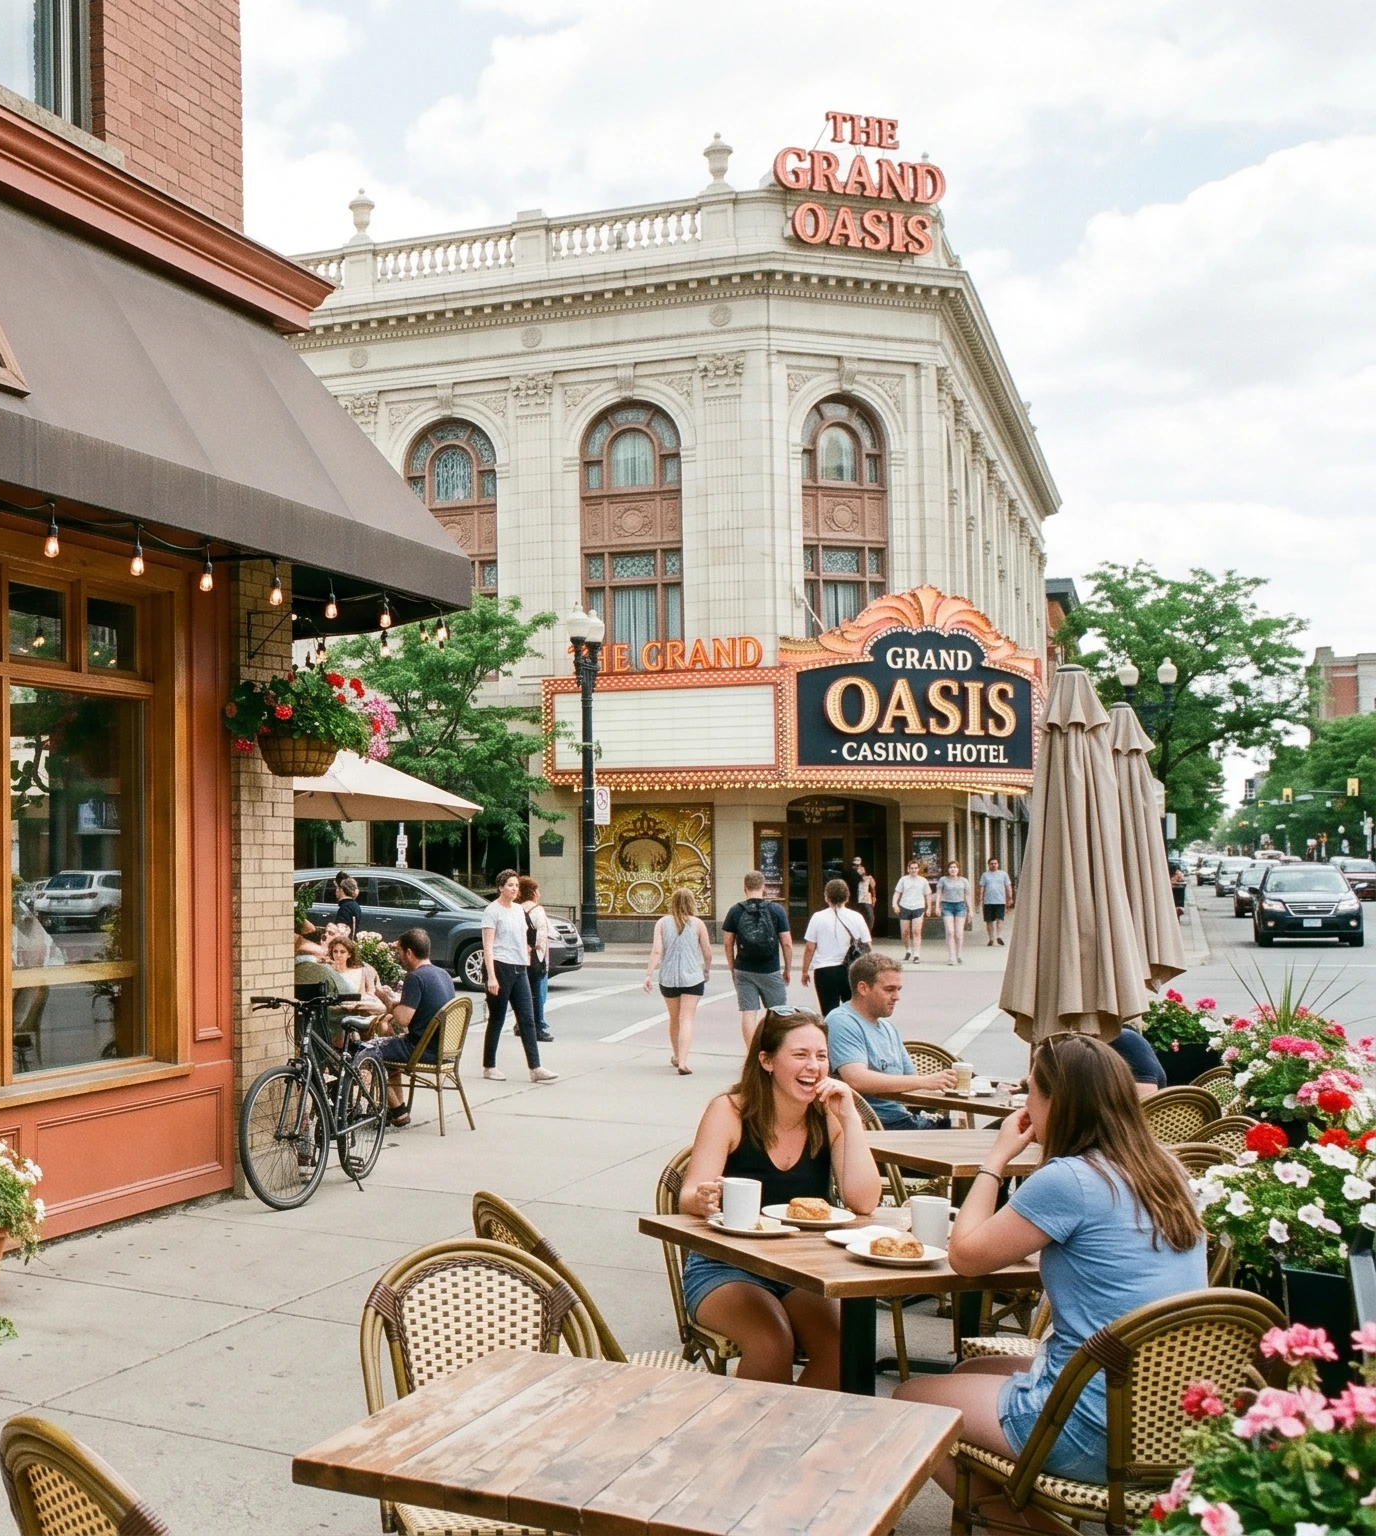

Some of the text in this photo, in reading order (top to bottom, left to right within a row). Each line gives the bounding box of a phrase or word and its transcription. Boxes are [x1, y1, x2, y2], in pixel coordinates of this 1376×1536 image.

[825, 110, 899, 150] THE
[774, 146, 947, 205] GRAND
[791, 202, 933, 256] OASIS
[641, 636, 764, 672] GRAND
[885, 646, 973, 671] GRAND
[824, 674, 1018, 738] OASIS
[841, 741, 1009, 764] CASINO HOTEL
